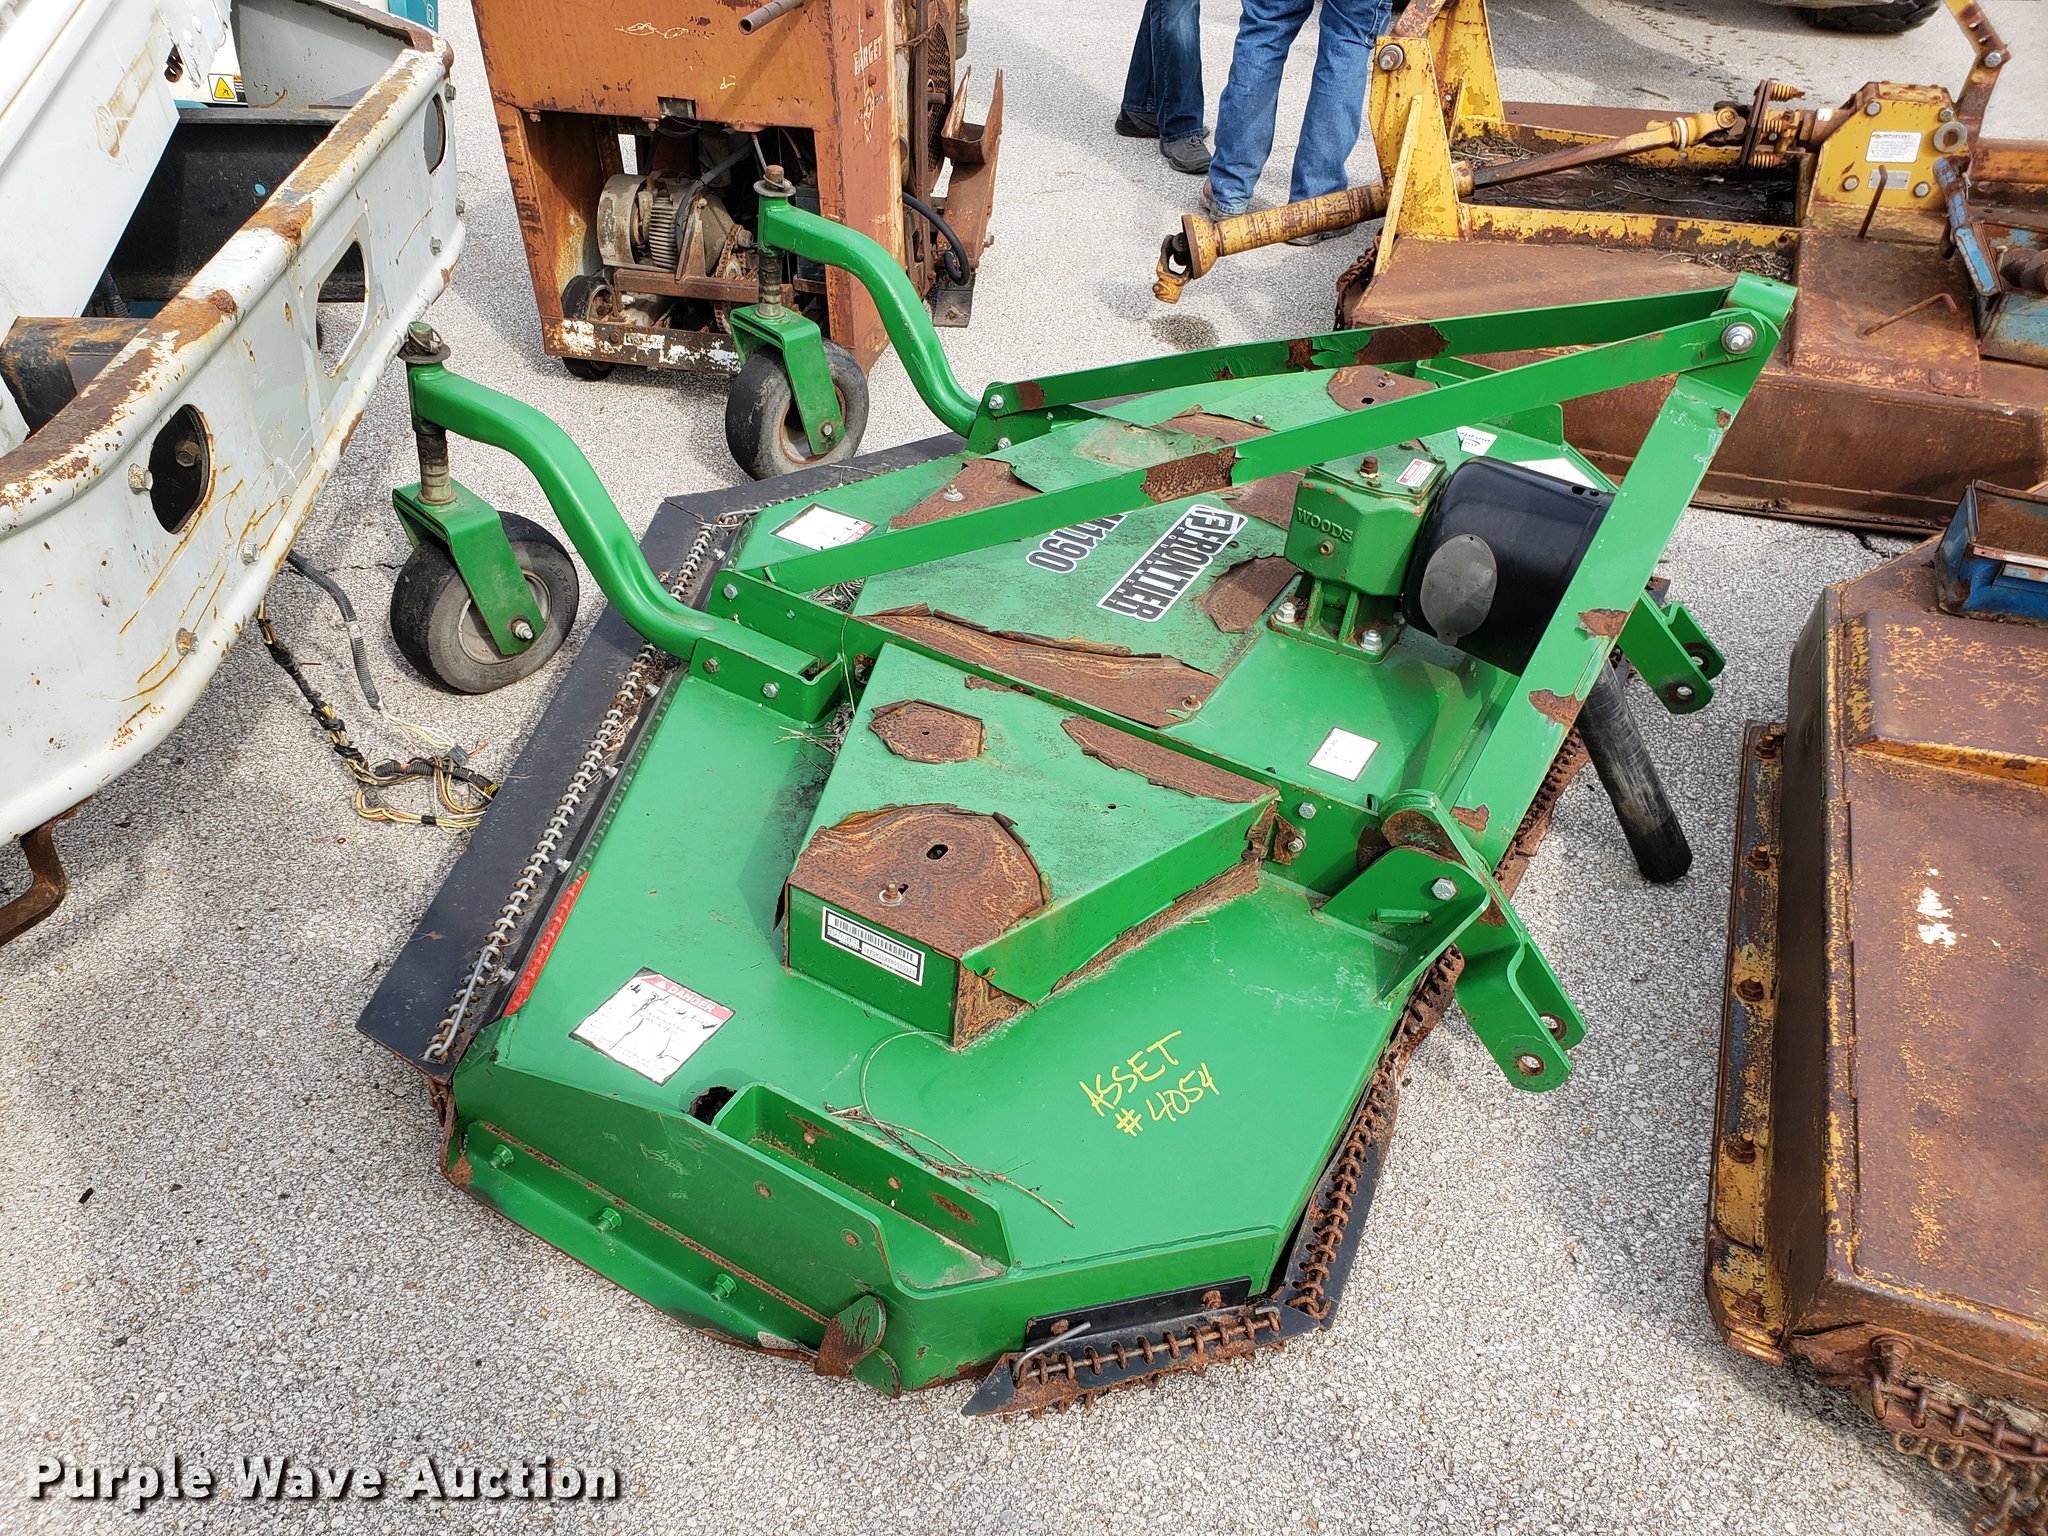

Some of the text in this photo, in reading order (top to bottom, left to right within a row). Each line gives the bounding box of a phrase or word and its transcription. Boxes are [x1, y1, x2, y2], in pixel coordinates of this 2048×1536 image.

[1297, 506, 1354, 542] WOODS
[1108, 525, 1185, 604] EQUIPMENT
[667, 983, 717, 1014] DANGER
[1079, 1030, 1182, 1117] ASSET
